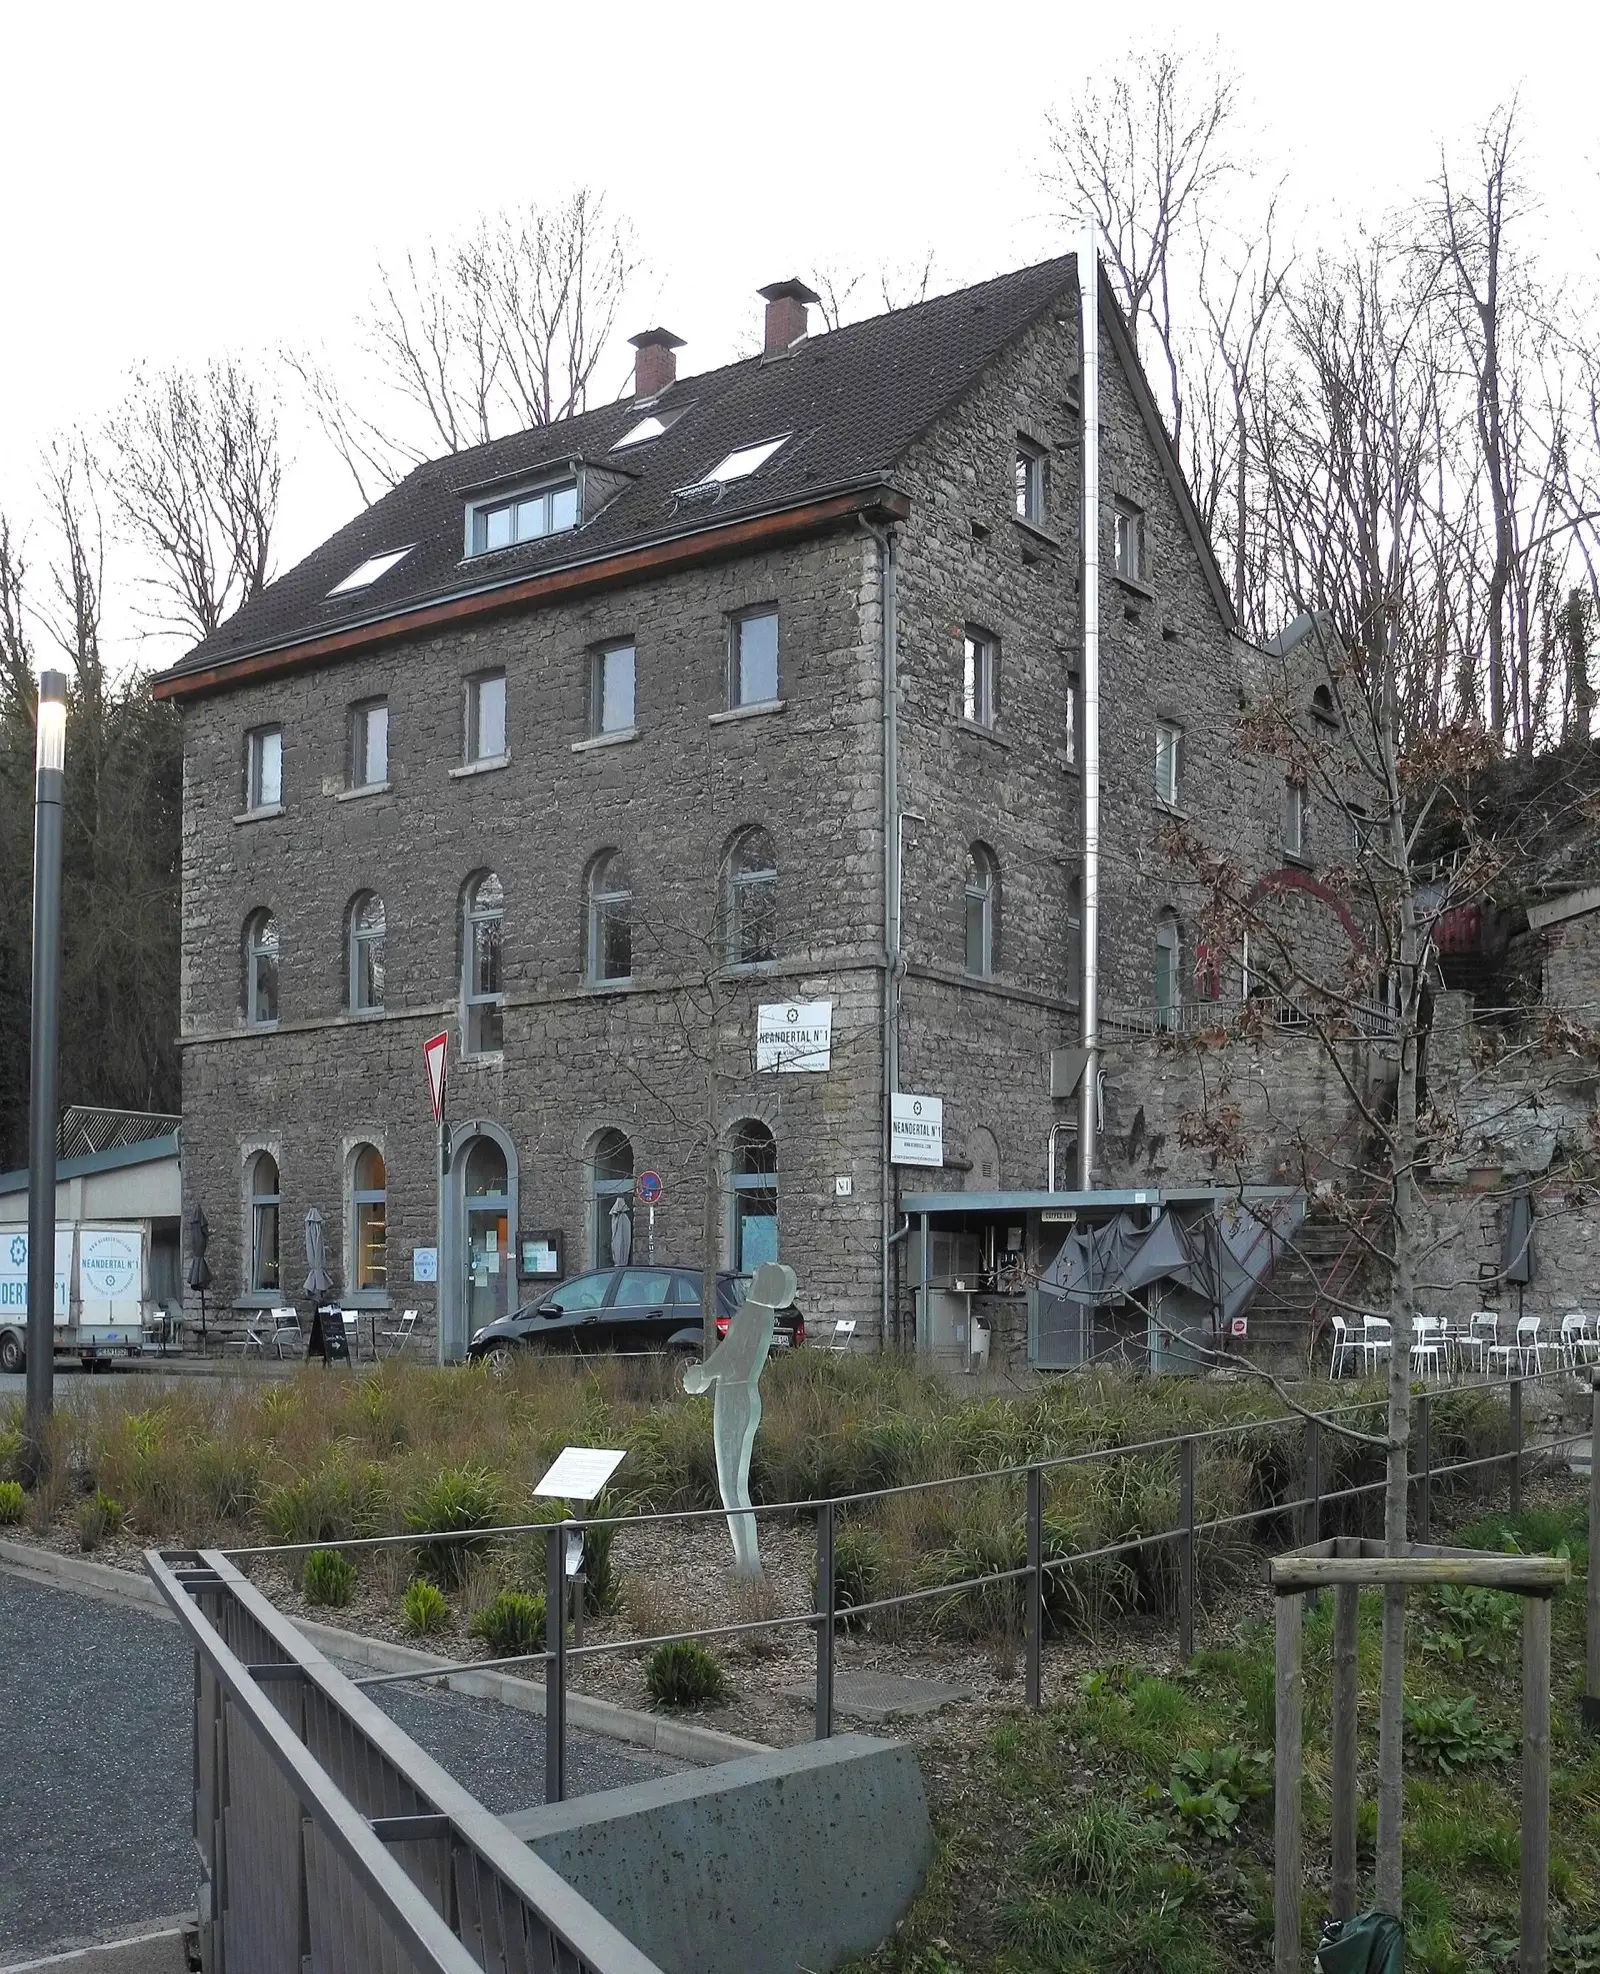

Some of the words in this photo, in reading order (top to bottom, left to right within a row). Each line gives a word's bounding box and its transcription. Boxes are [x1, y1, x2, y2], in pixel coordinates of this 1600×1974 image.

[759, 1030, 810, 1044] NEANDERTAL
[893, 1121, 930, 1136] NEANDERTAL
[82, 1258, 125, 1269] NEANDERTAL
